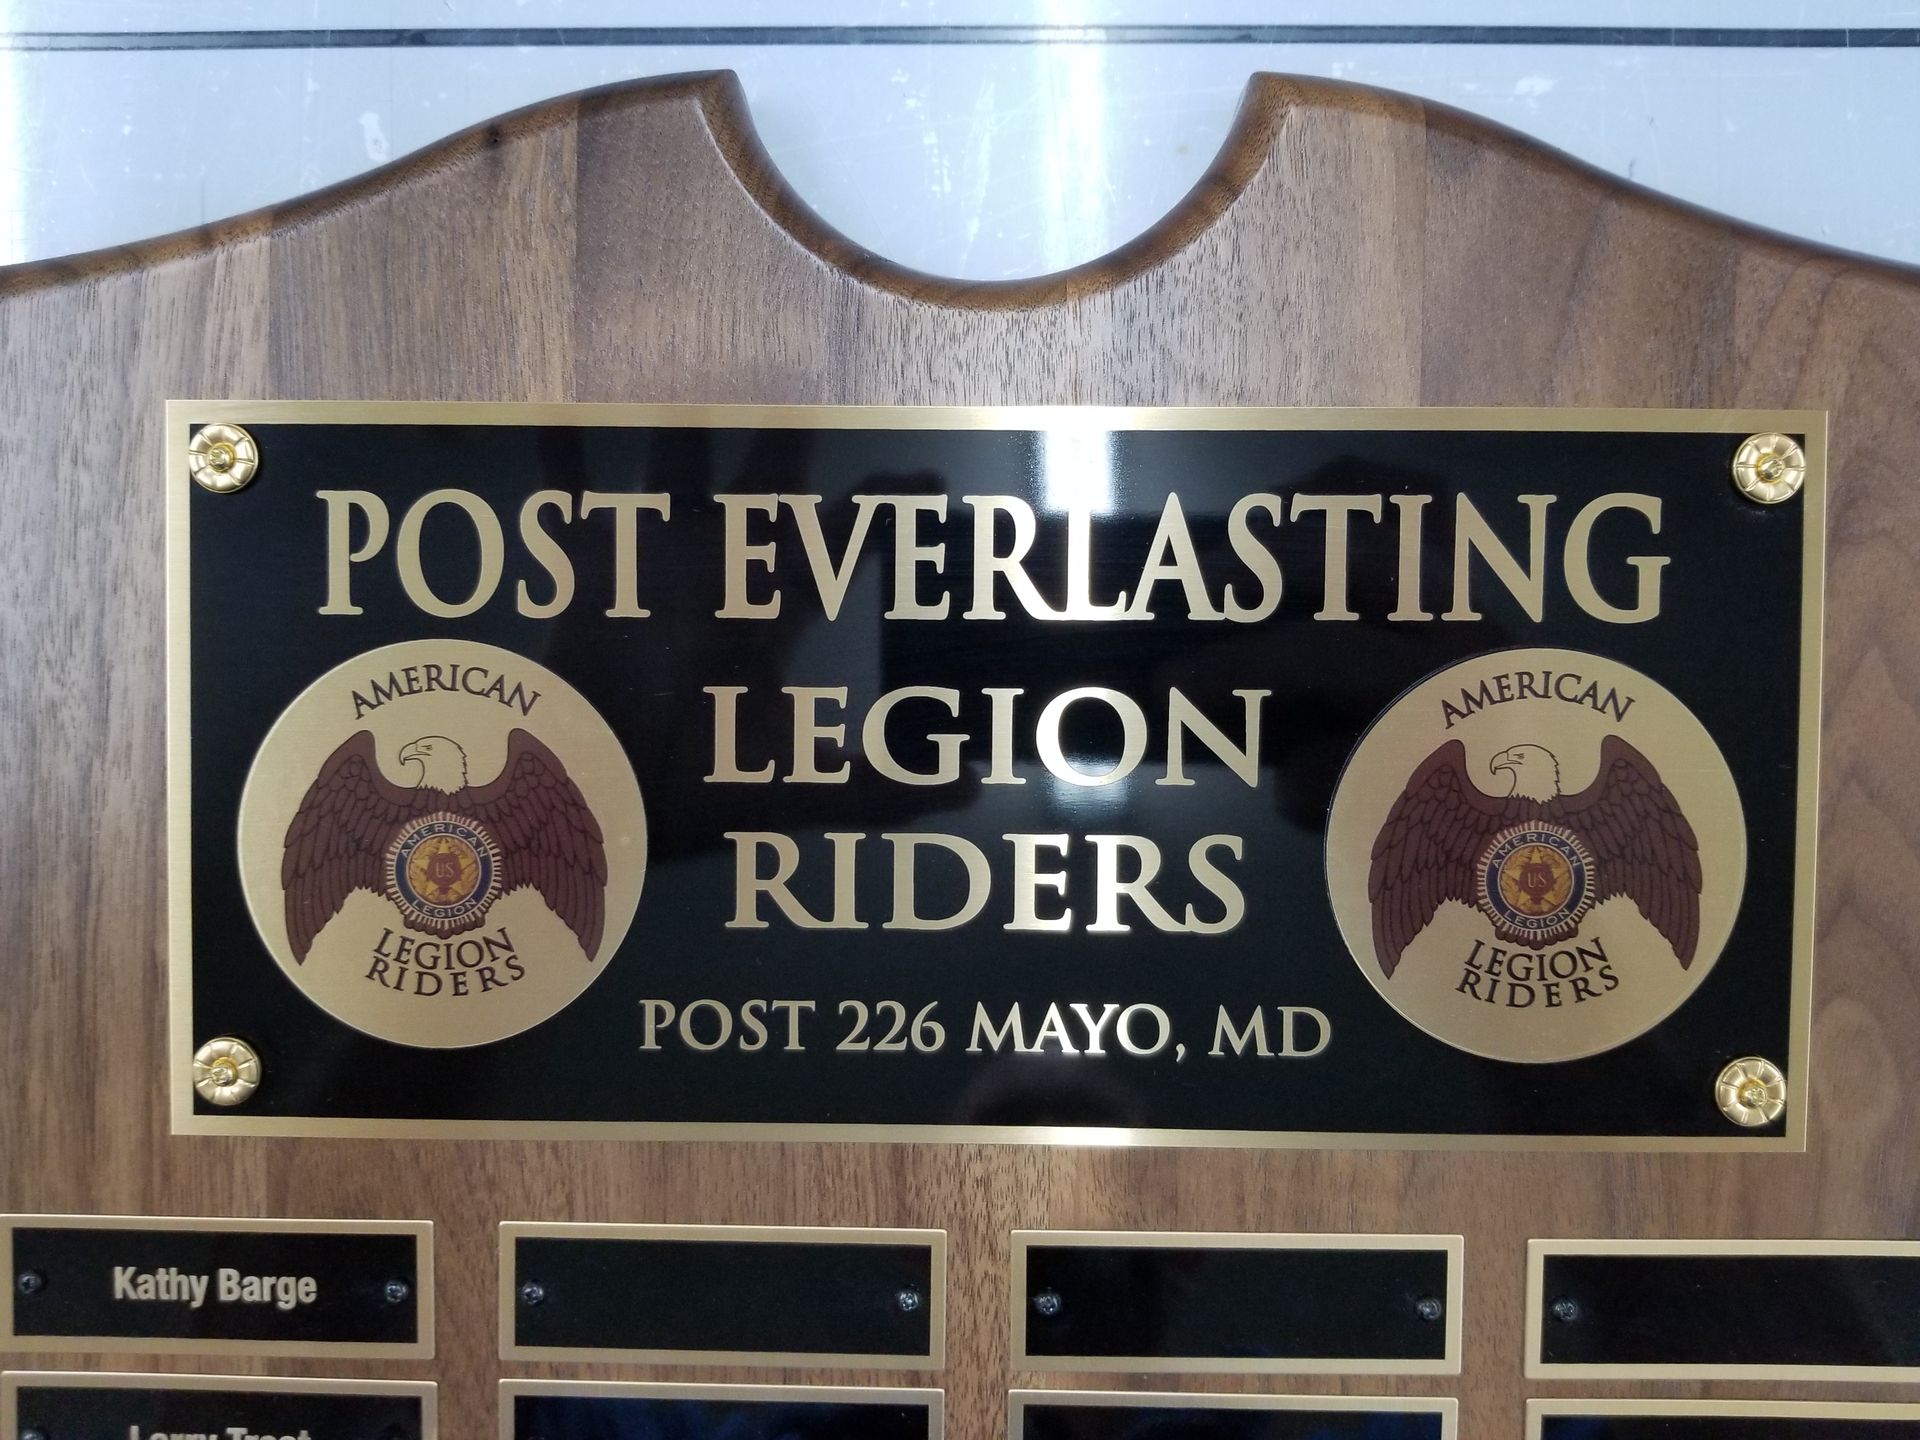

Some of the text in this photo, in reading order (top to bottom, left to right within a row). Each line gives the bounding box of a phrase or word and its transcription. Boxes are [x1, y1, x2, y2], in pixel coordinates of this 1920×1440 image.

[316, 488, 1671, 624] POST EVERLASTING
[351, 664, 540, 719] AMERICAN
[1440, 671, 1635, 729] AMERICAN
[703, 685, 1272, 788] LEGION
[401, 823, 488, 859] AMERICAN
[1492, 832, 1581, 869] AMERICAN
[435, 861, 455, 879] US
[723, 831, 1246, 934] RIDERS
[1527, 871, 1547, 888] US
[412, 897, 477, 918] LEGION
[1503, 907, 1571, 929] LEGION
[373, 927, 516, 971] LEGION
[1464, 937, 1609, 982] LEGION
[365, 955, 526, 997] RIDERS
[1455, 966, 1619, 1008] RIDERS
[639, 999, 1332, 1062] POST 226 MAYO, MD
[113, 1266, 318, 1310] Kathy Barge
